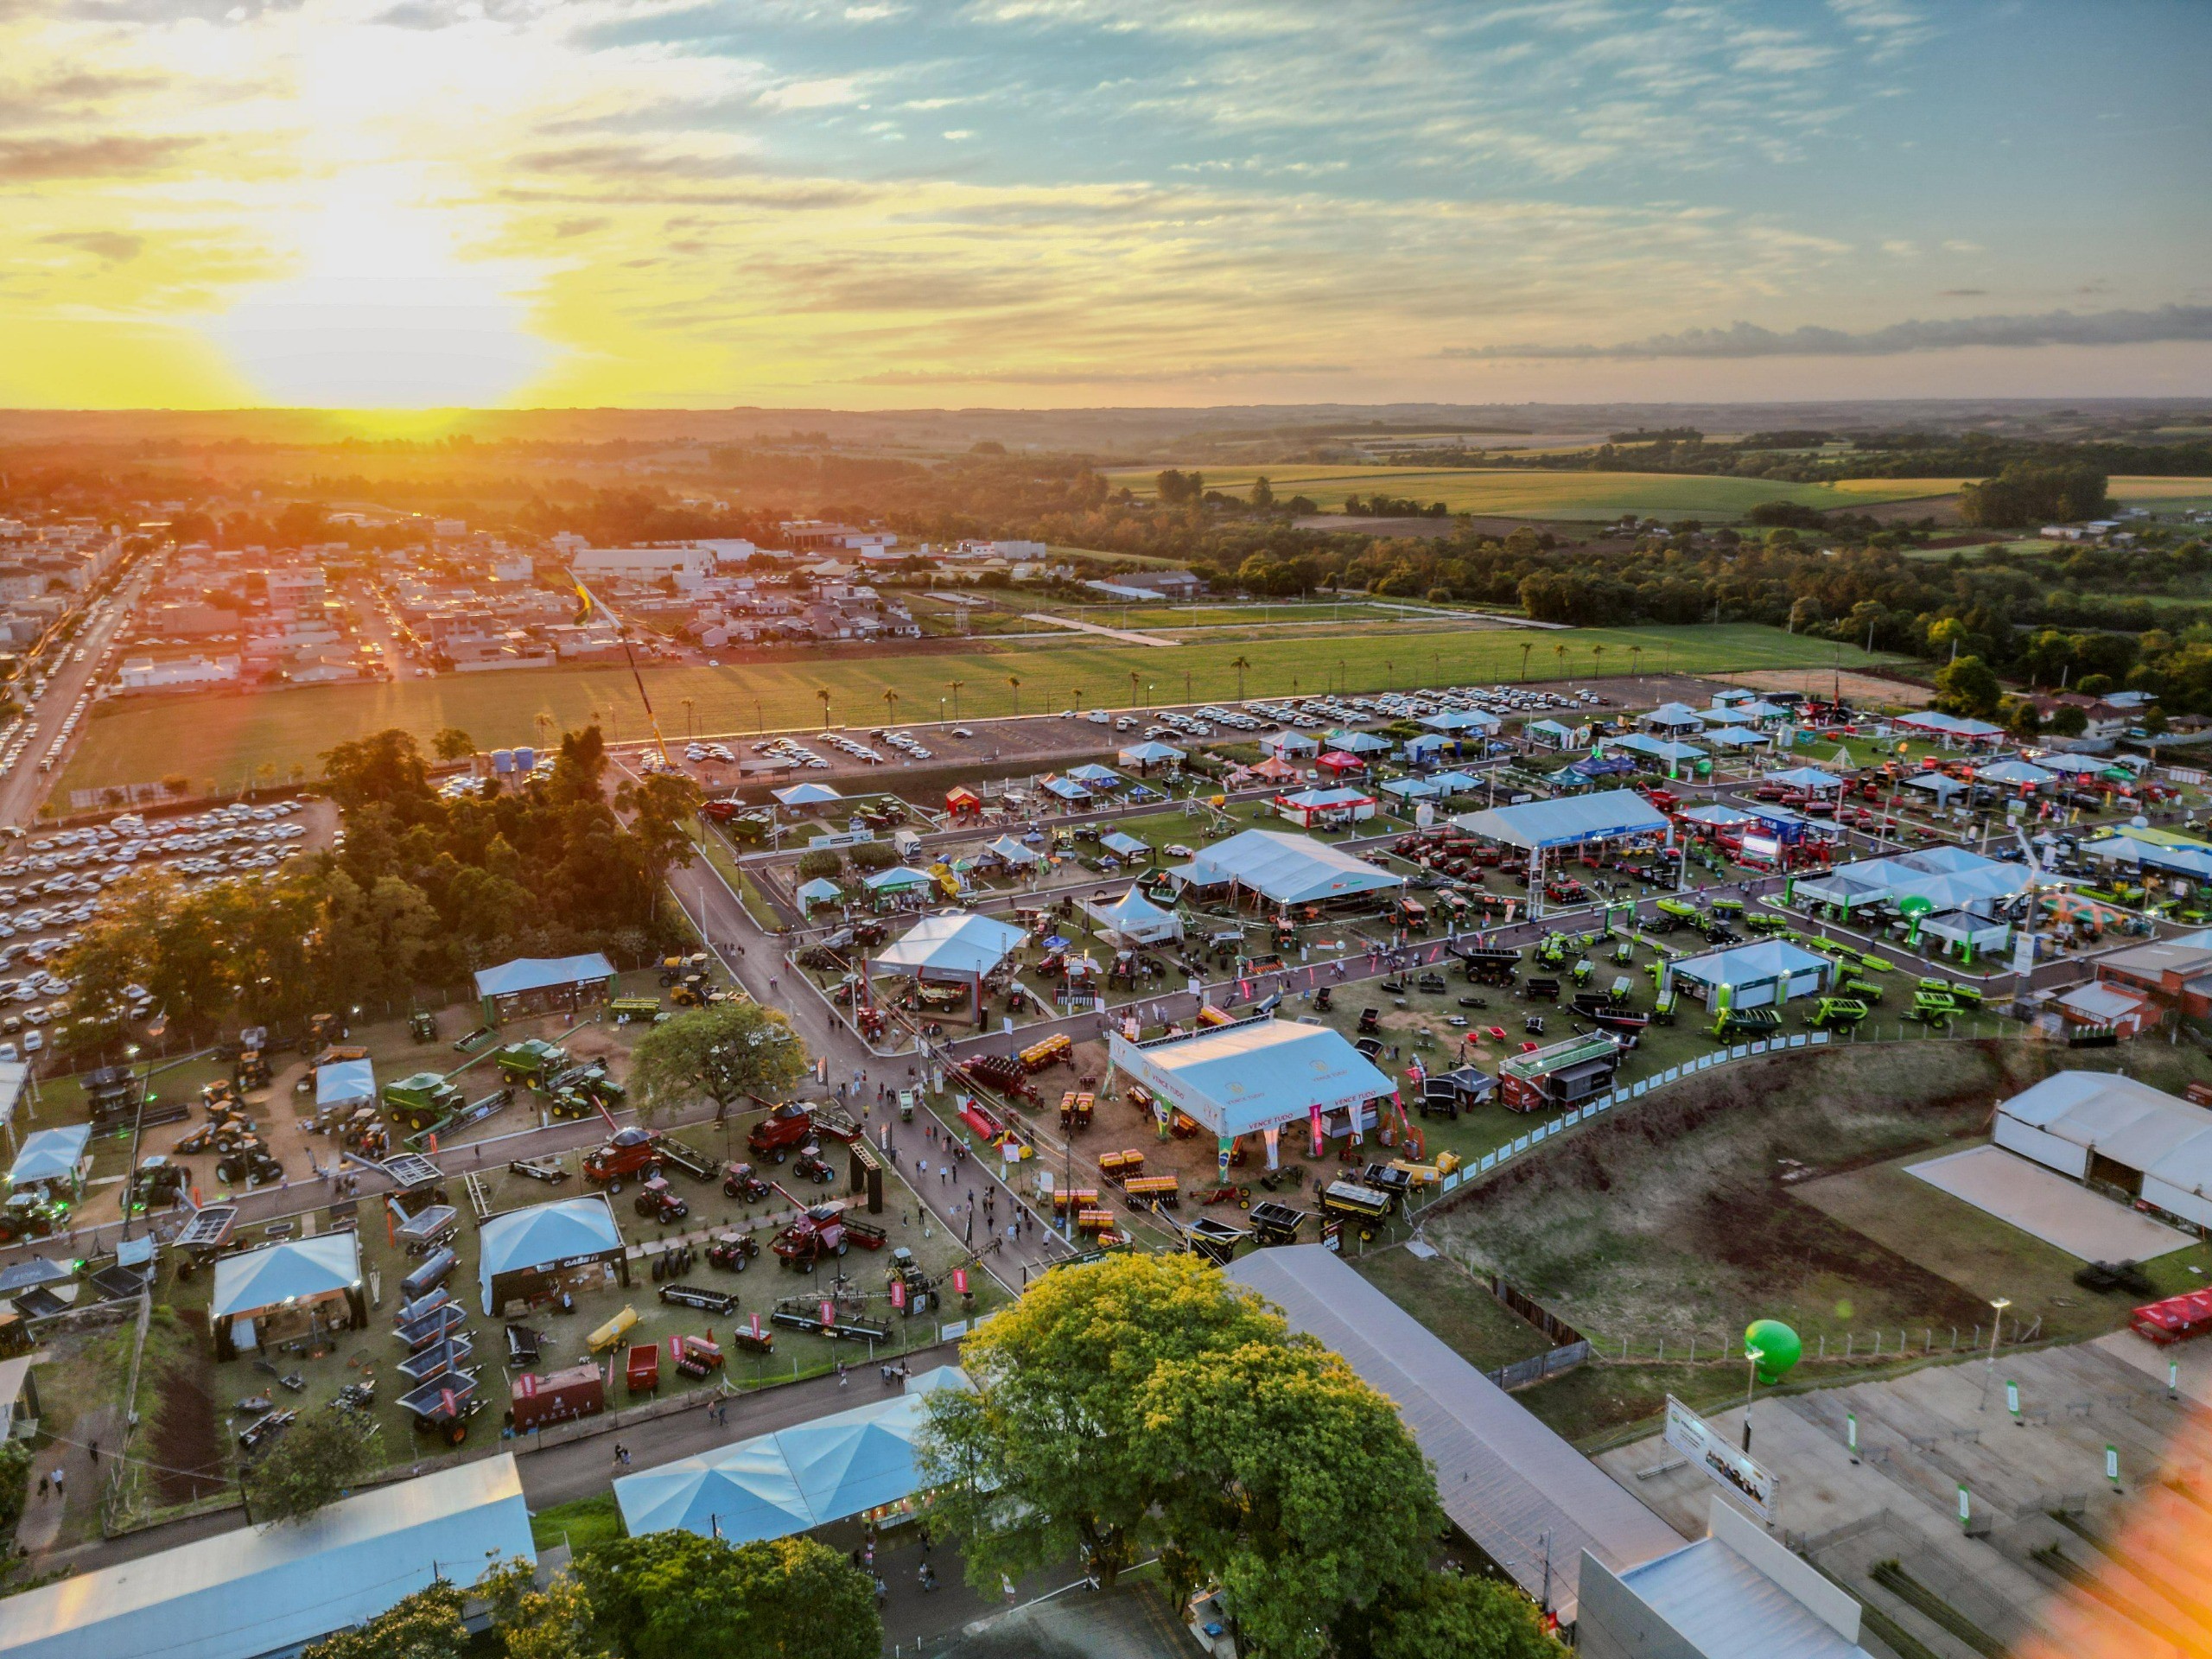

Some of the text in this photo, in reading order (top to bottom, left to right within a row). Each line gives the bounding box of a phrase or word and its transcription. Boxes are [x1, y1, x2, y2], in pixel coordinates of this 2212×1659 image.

[1152, 1074, 1185, 1100] VENCE TUDO
[1335, 1090, 1376, 1106] VENCE TUDO
[1249, 1113, 1294, 1129] VENCE TUDO
[563, 1256, 590, 1268] CASE
